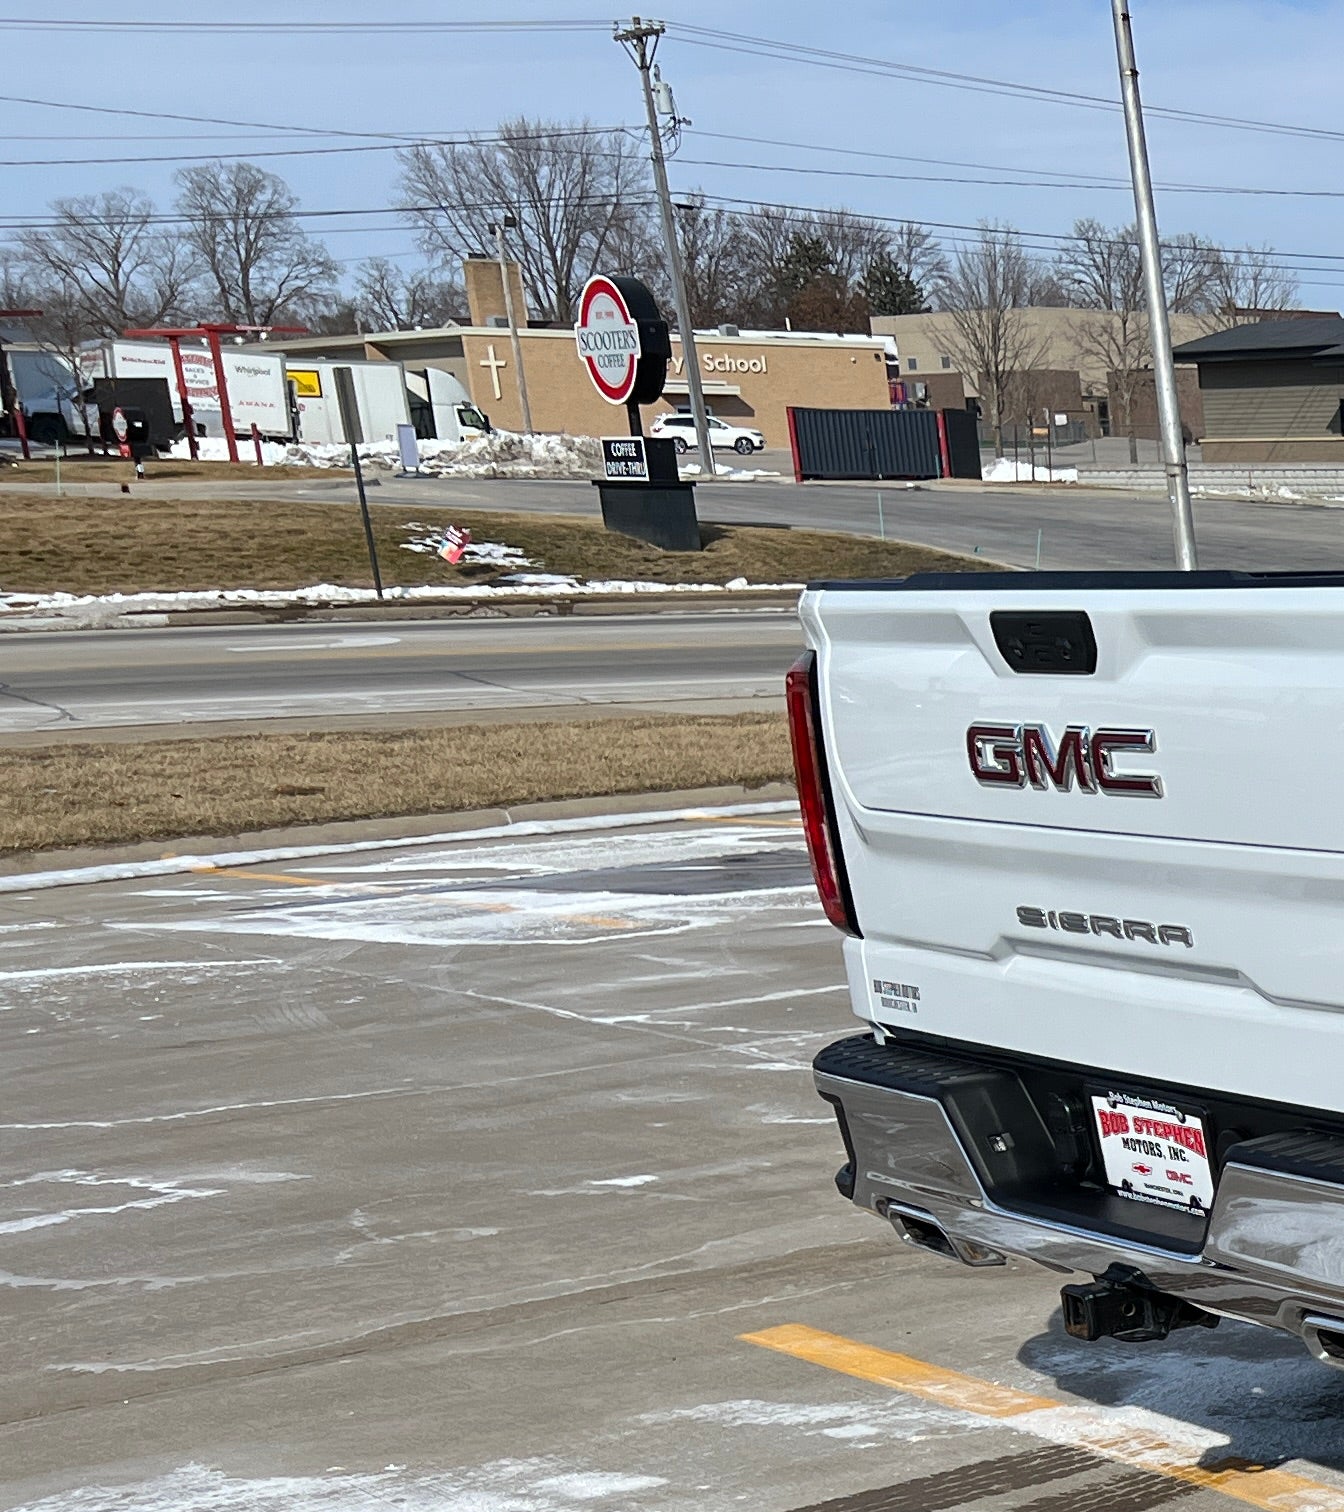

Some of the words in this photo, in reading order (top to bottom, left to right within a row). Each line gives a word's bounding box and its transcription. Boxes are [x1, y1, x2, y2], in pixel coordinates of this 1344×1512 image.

[580, 329, 638, 351] SCOOTER'S
[597, 353, 625, 368] COFFEE
[703, 353, 768, 374] School
[235, 366, 271, 377] Whirlpool
[611, 442, 637, 457] COFFEE
[966, 720, 1165, 799] GMC
[1016, 905, 1194, 949] SIERRA
[1097, 1109, 1129, 1138] BOB
[1132, 1115, 1207, 1159] STEPHEN
[1121, 1137, 1167, 1160] MOTORS,
[1168, 1145, 1189, 1162] INC.
[1166, 1169, 1193, 1185] GMC
